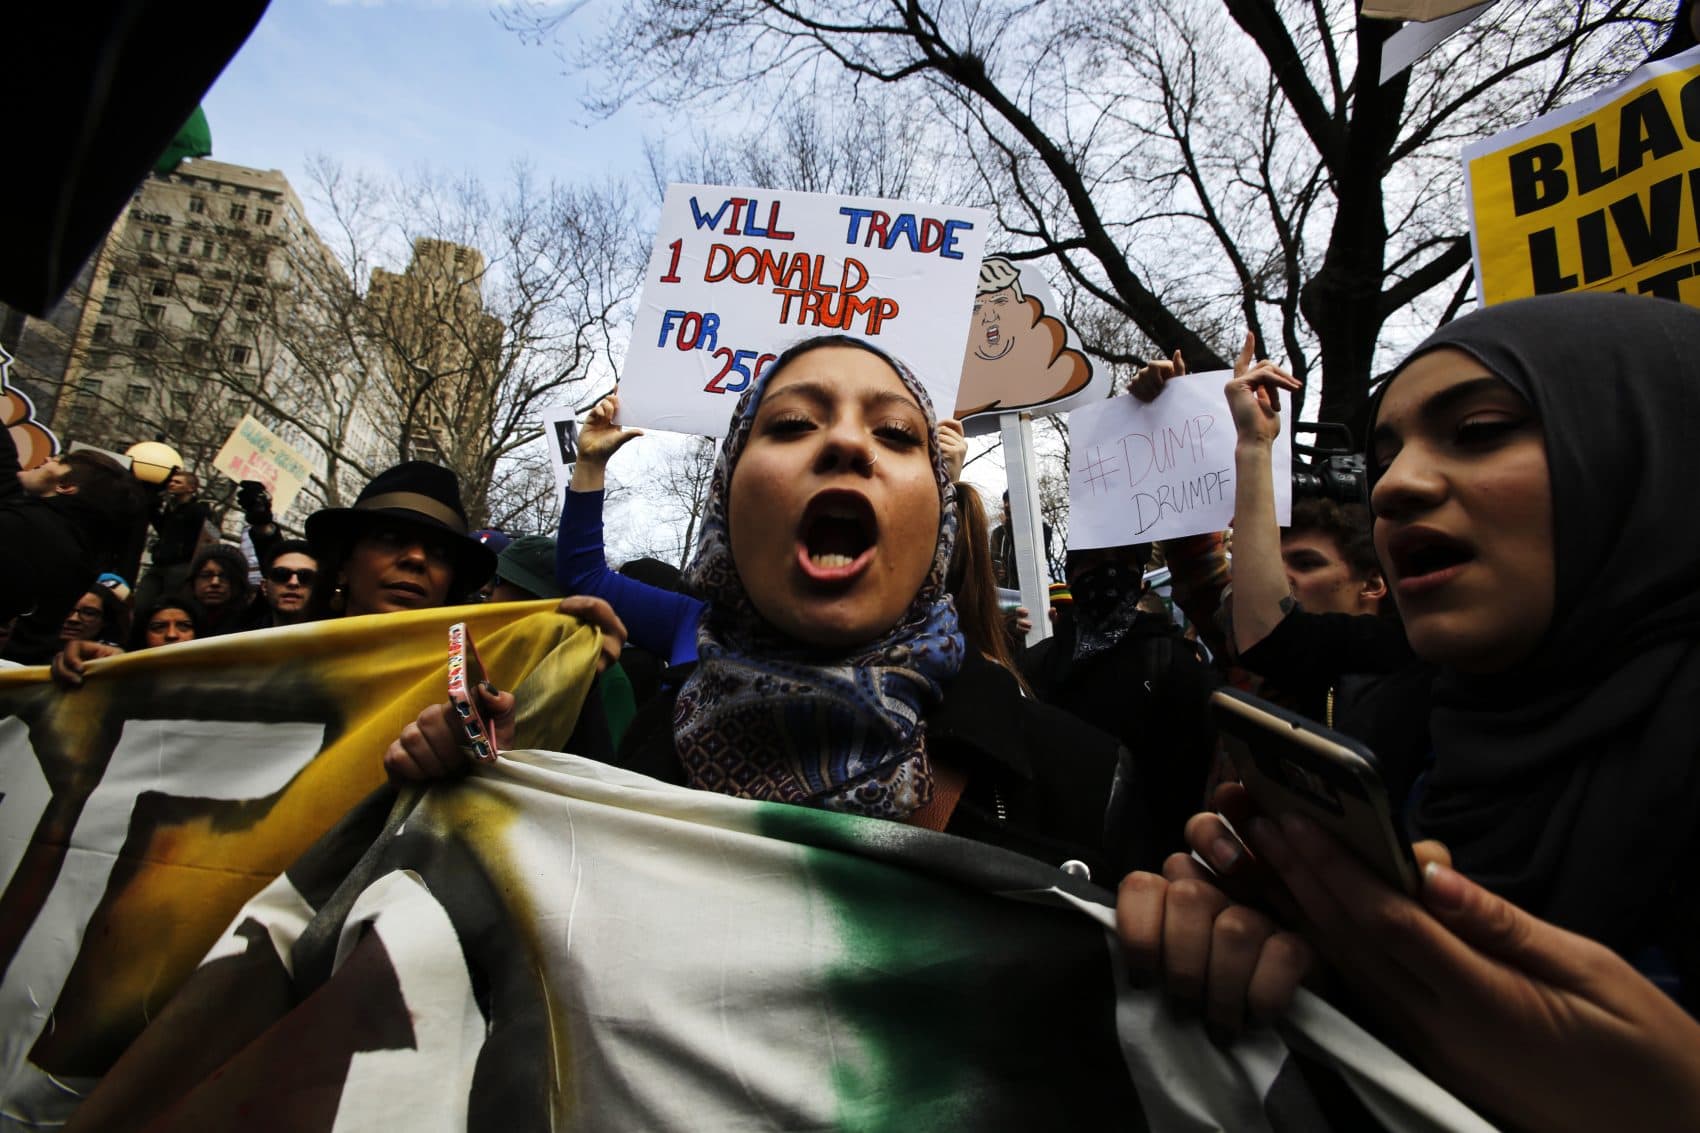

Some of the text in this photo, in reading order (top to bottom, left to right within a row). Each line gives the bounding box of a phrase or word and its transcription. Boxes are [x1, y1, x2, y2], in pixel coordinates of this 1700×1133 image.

[689, 196, 974, 260] WILL TRADE
[660, 238, 869, 294] 1 DONALD
[657, 310, 720, 351] FOR
[773, 287, 900, 336] TRUMP
[1078, 414, 1215, 497] #DUMP
[1130, 468, 1231, 535] DRUMPF
